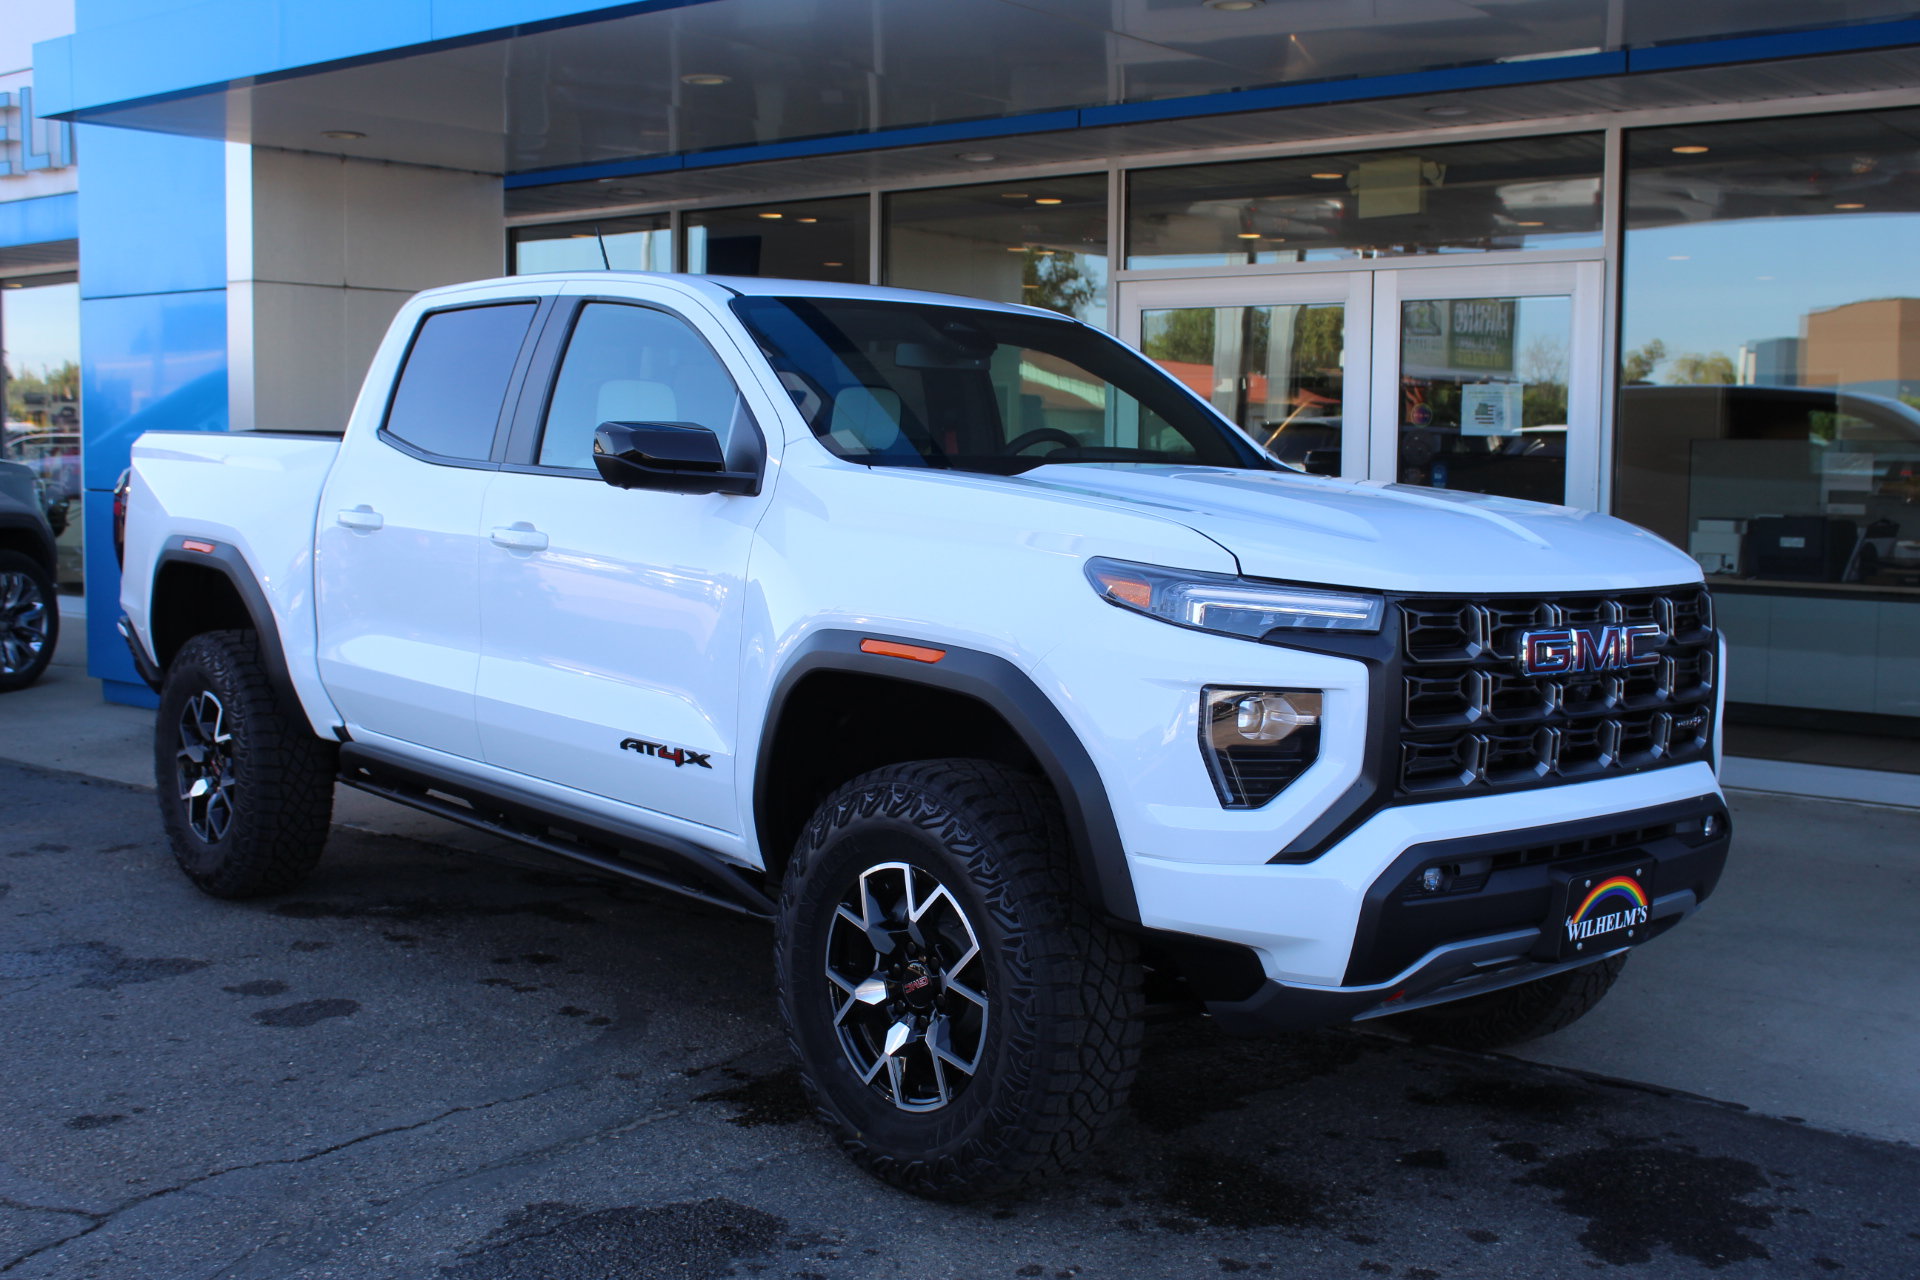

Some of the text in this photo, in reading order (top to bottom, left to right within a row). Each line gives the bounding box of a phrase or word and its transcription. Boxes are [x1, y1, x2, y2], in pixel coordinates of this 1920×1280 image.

[1522, 625, 1660, 676] GMC
[620, 737, 712, 769] AT4X
[1567, 905, 1648, 941] WILHELM'S
